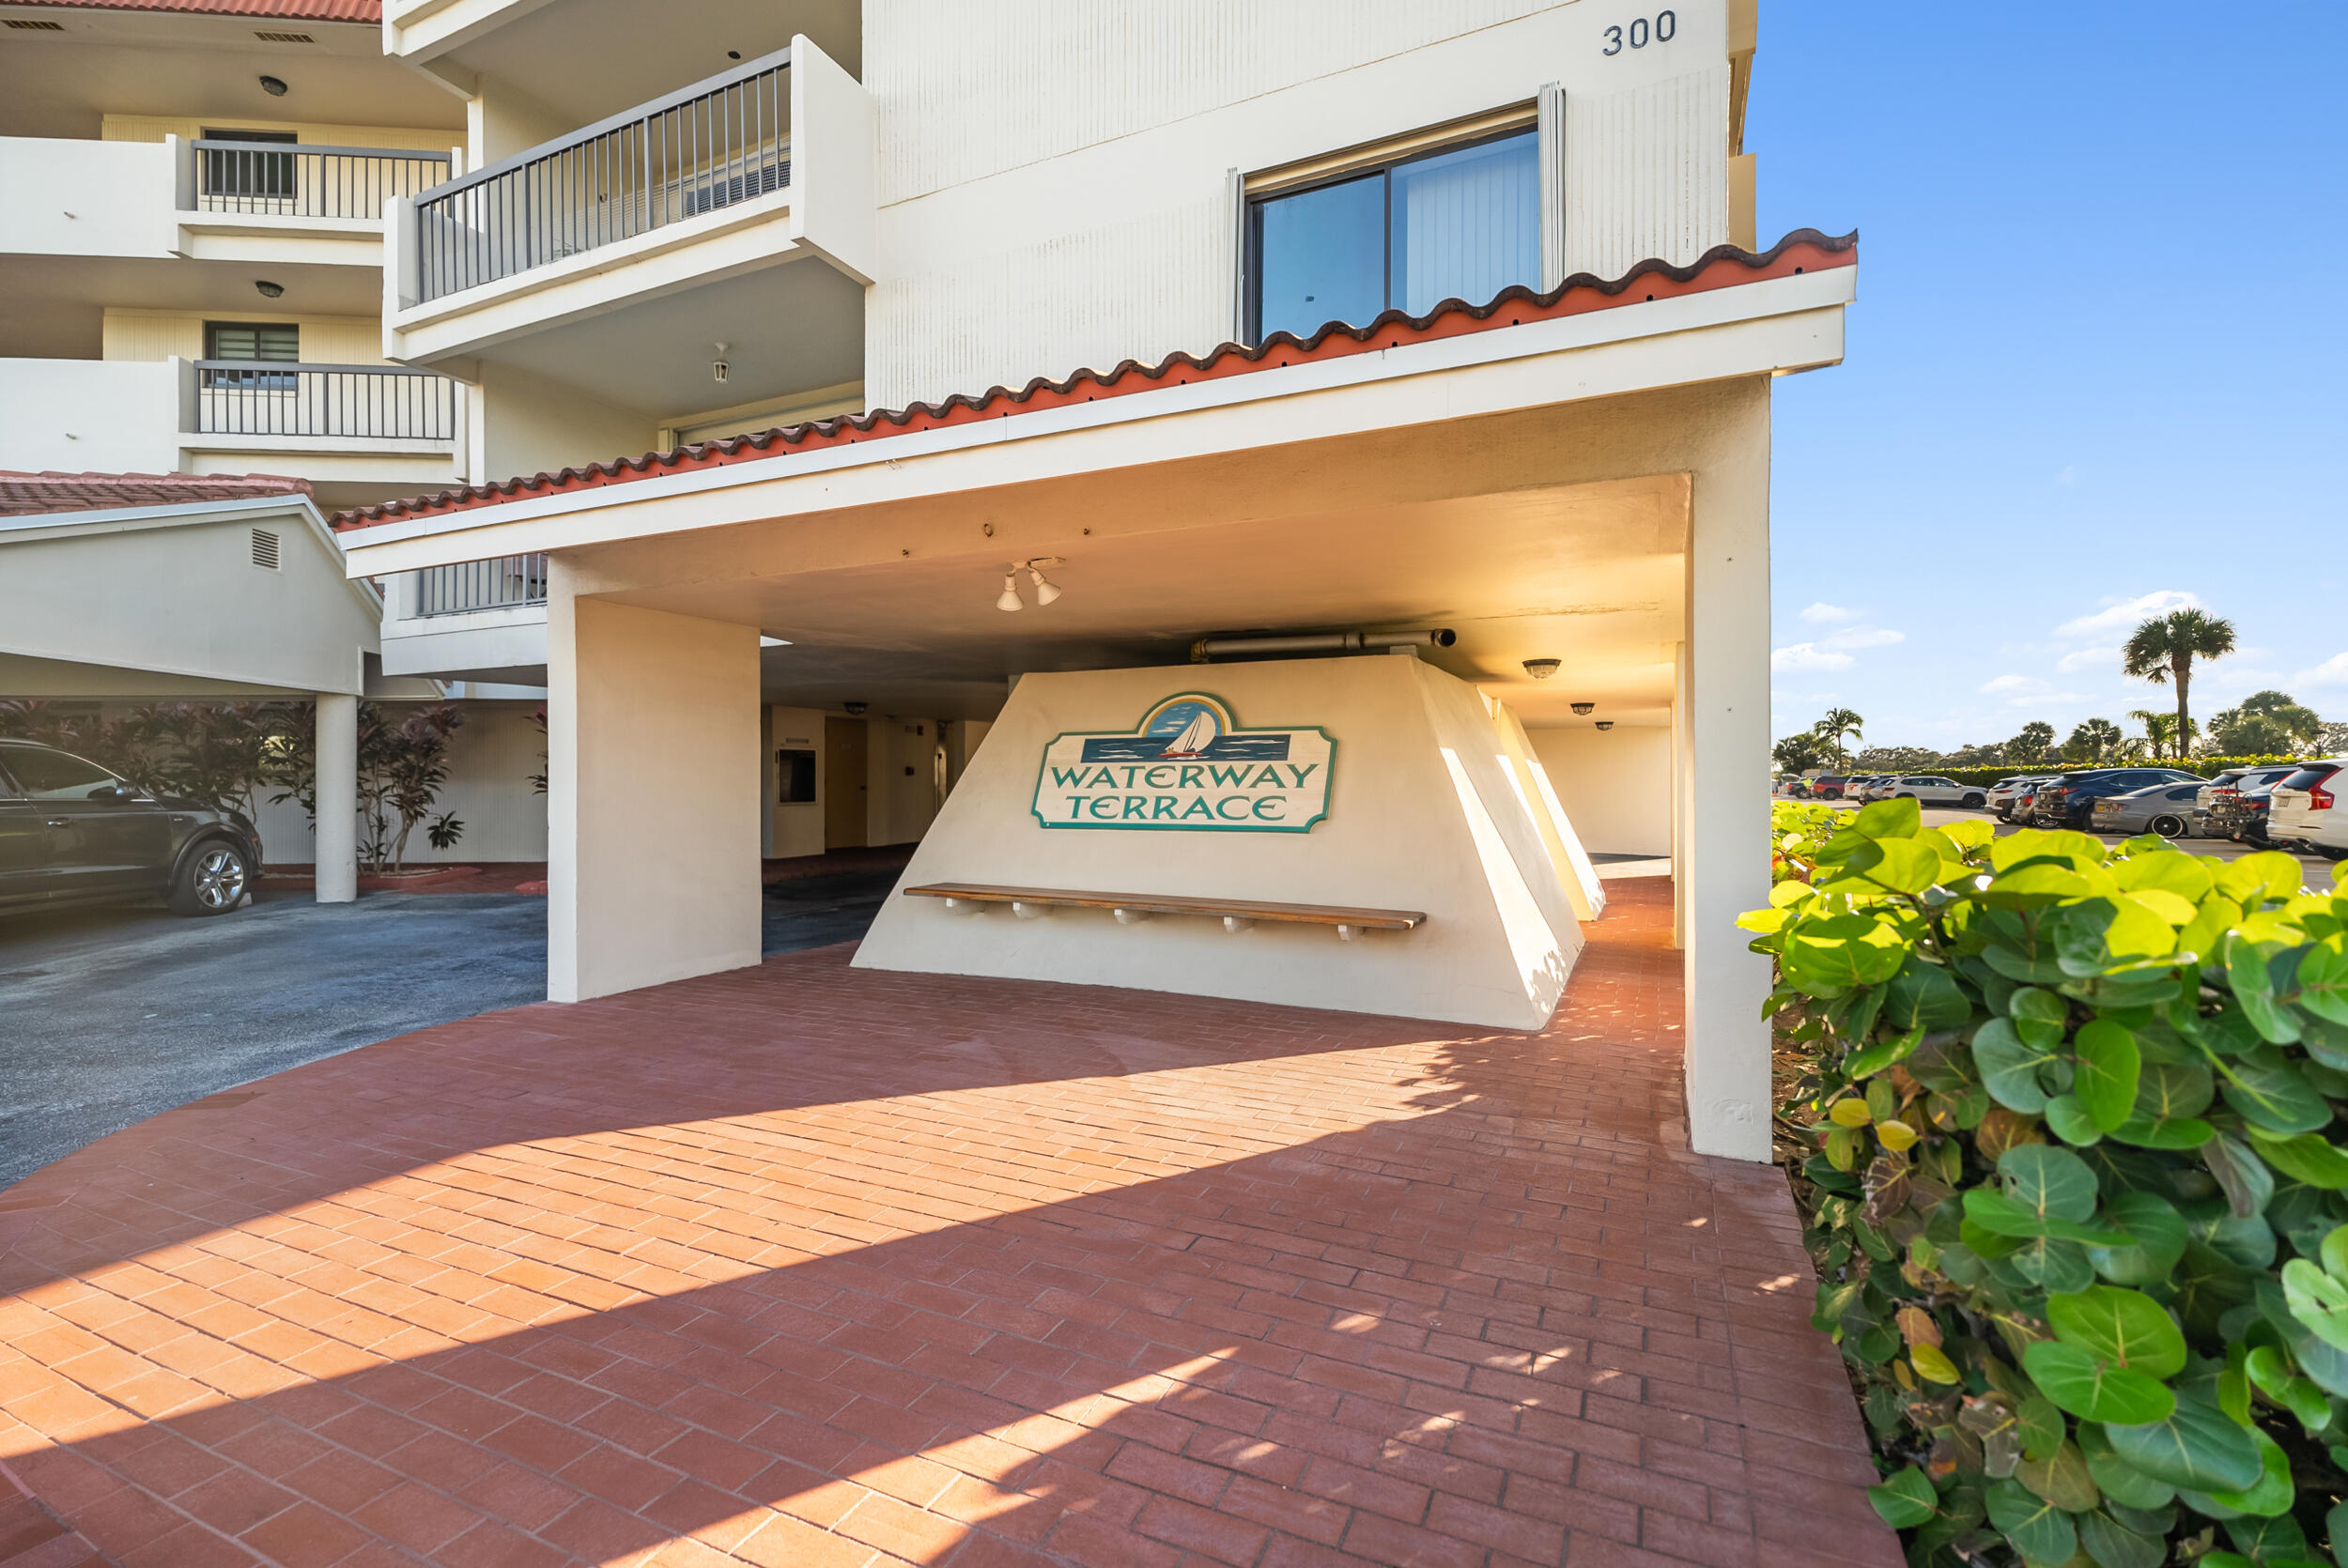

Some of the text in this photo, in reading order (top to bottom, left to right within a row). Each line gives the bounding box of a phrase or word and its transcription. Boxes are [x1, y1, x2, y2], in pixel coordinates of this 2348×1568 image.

[1602, 9, 1676, 56] 300
[1050, 763, 1321, 790] WATERWAY
[1065, 795, 1287, 822] TERRACE
